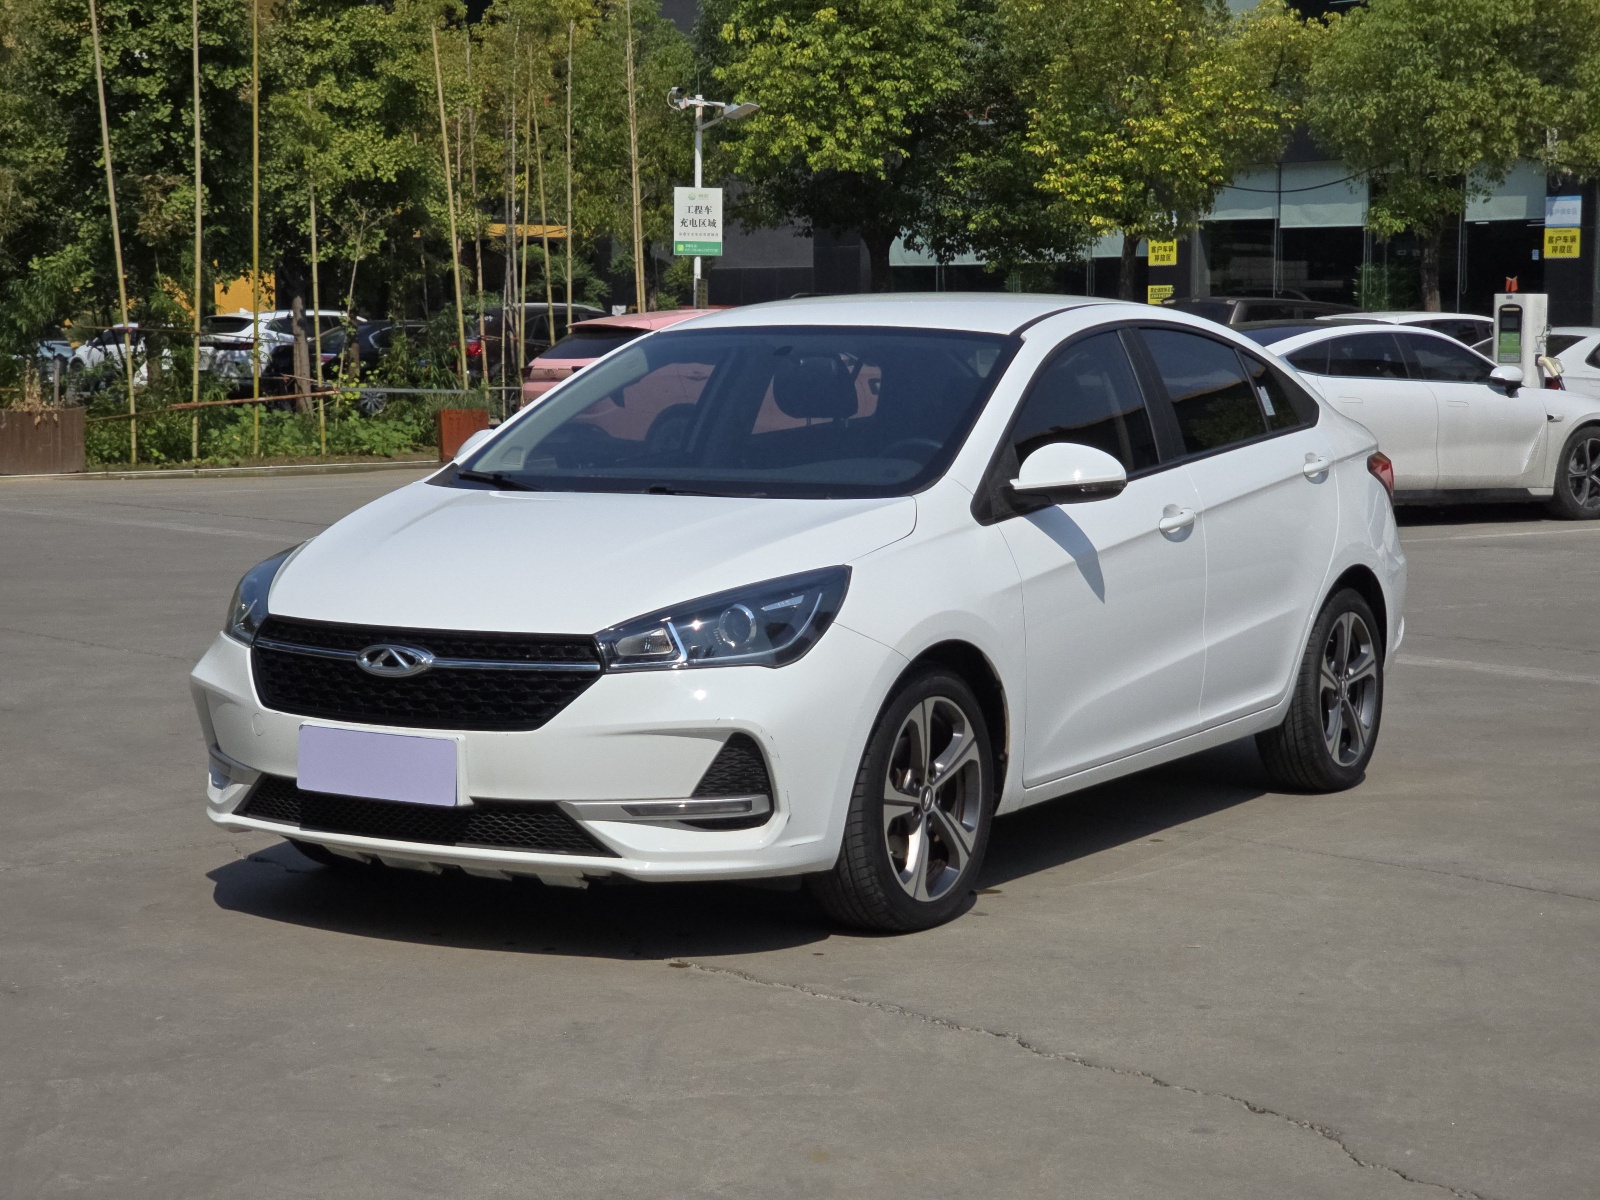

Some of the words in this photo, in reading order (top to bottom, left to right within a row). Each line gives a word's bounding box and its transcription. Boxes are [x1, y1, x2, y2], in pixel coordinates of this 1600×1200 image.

[685, 205, 712, 215] 工程车
[679, 218, 717, 228] 充电区域
[1547, 235, 1577, 244] 客户车辆
